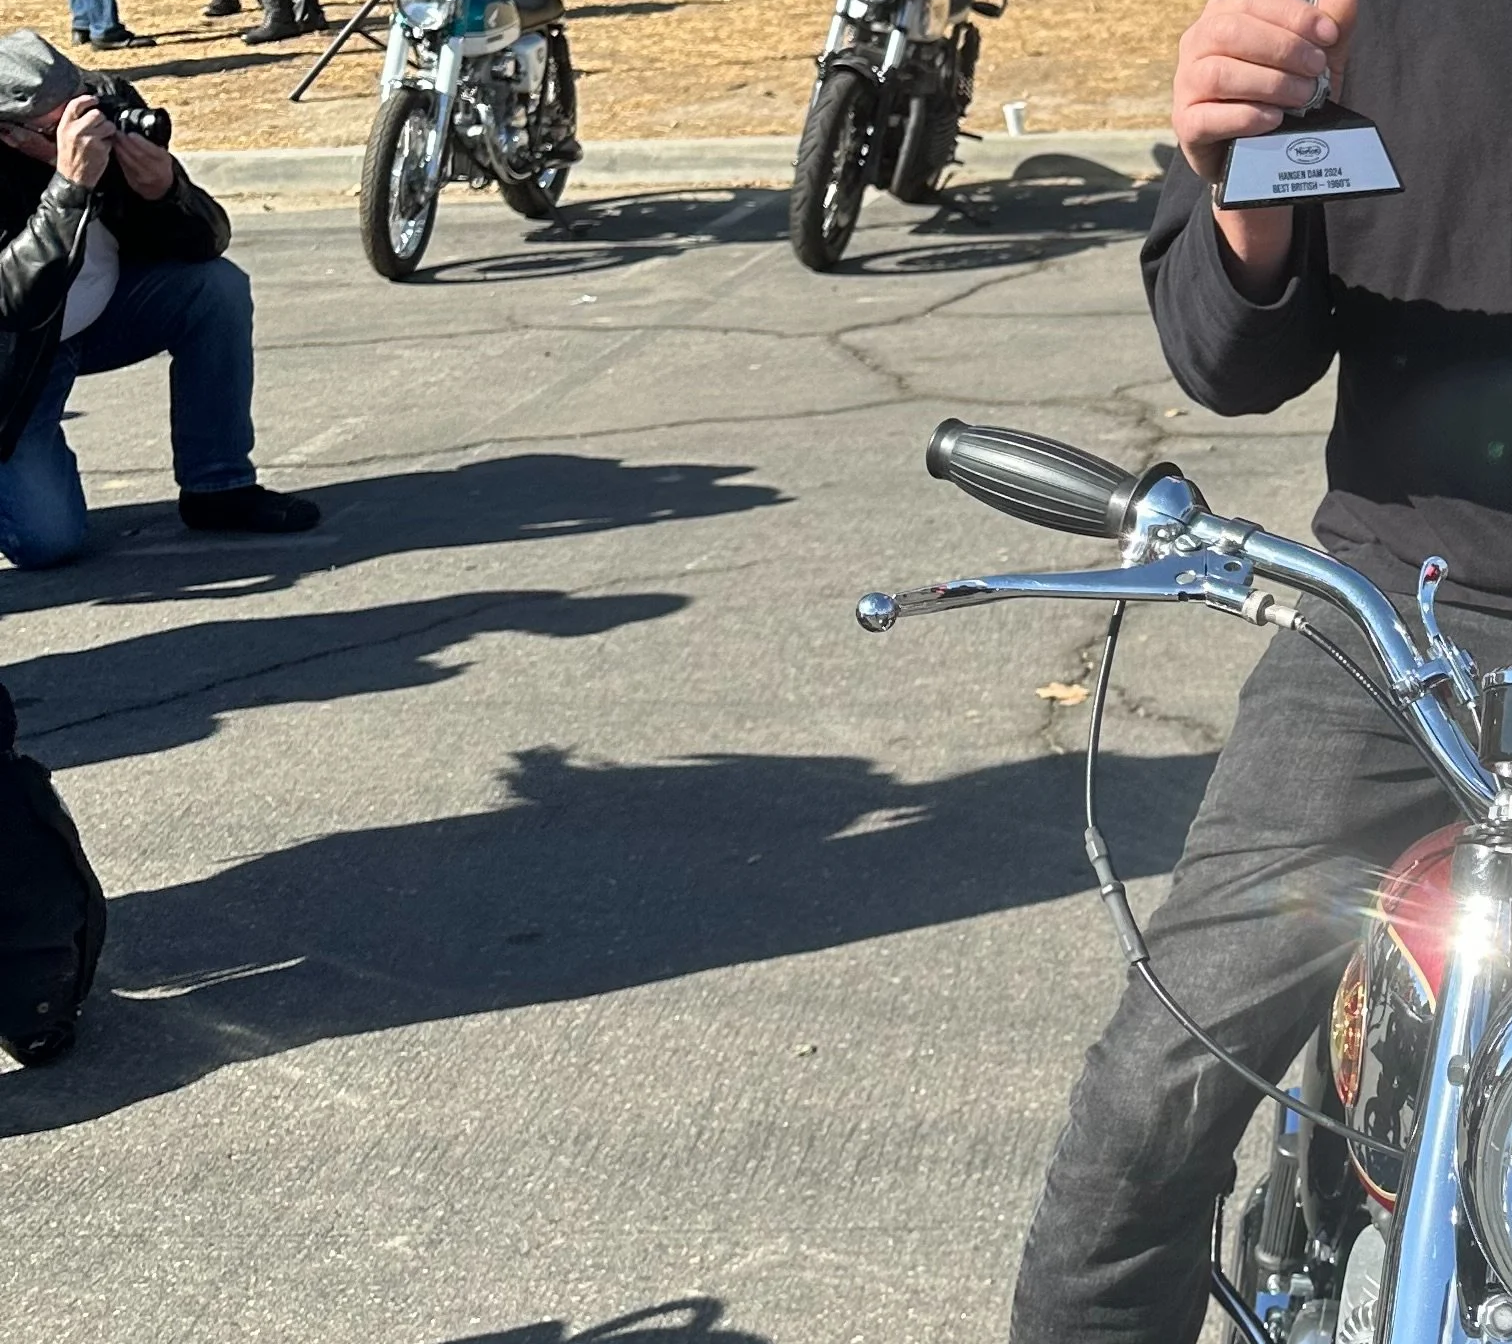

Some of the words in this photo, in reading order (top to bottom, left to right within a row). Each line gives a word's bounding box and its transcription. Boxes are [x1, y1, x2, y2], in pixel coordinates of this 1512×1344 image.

[1278, 170, 1306, 181] HANSEN
[1307, 168, 1323, 179] DAM
[1324, 167, 1343, 177] 2024
[1272, 183, 1290, 194] BEST
[1291, 182, 1318, 192] BRITISH
